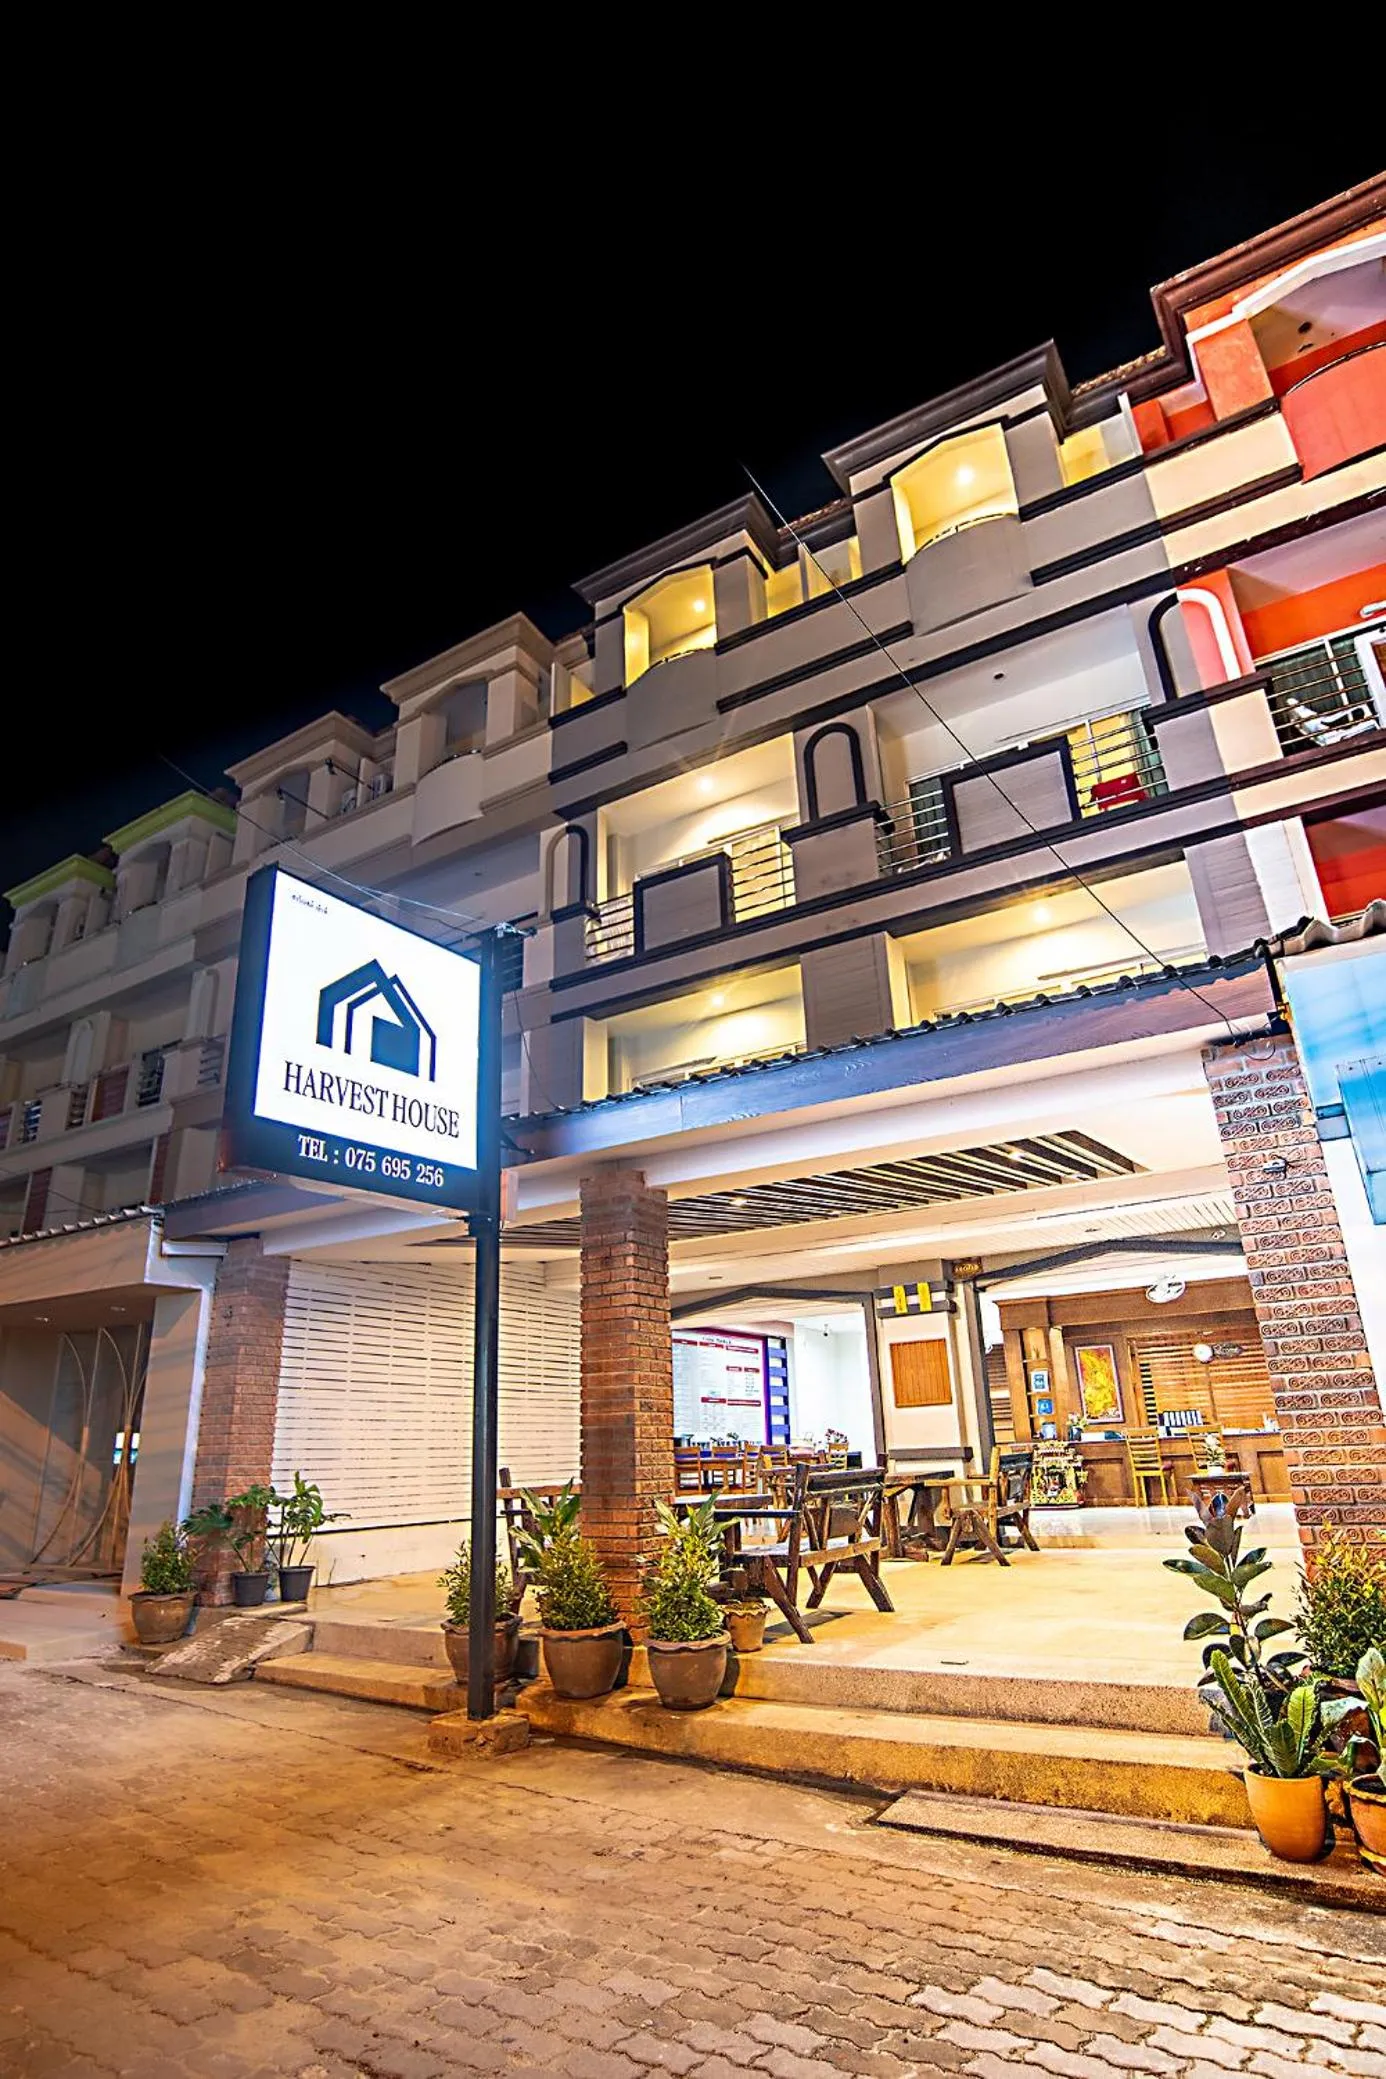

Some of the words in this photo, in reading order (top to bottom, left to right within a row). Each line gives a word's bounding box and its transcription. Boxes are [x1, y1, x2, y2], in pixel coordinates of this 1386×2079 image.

[283, 1060, 389, 1118] HARVEST
[392, 1093, 460, 1138] HOUSE
[298, 1134, 328, 1162] TEL
[345, 1147, 376, 1172] 075
[381, 1155, 411, 1180] 695
[416, 1163, 444, 1187] 256
